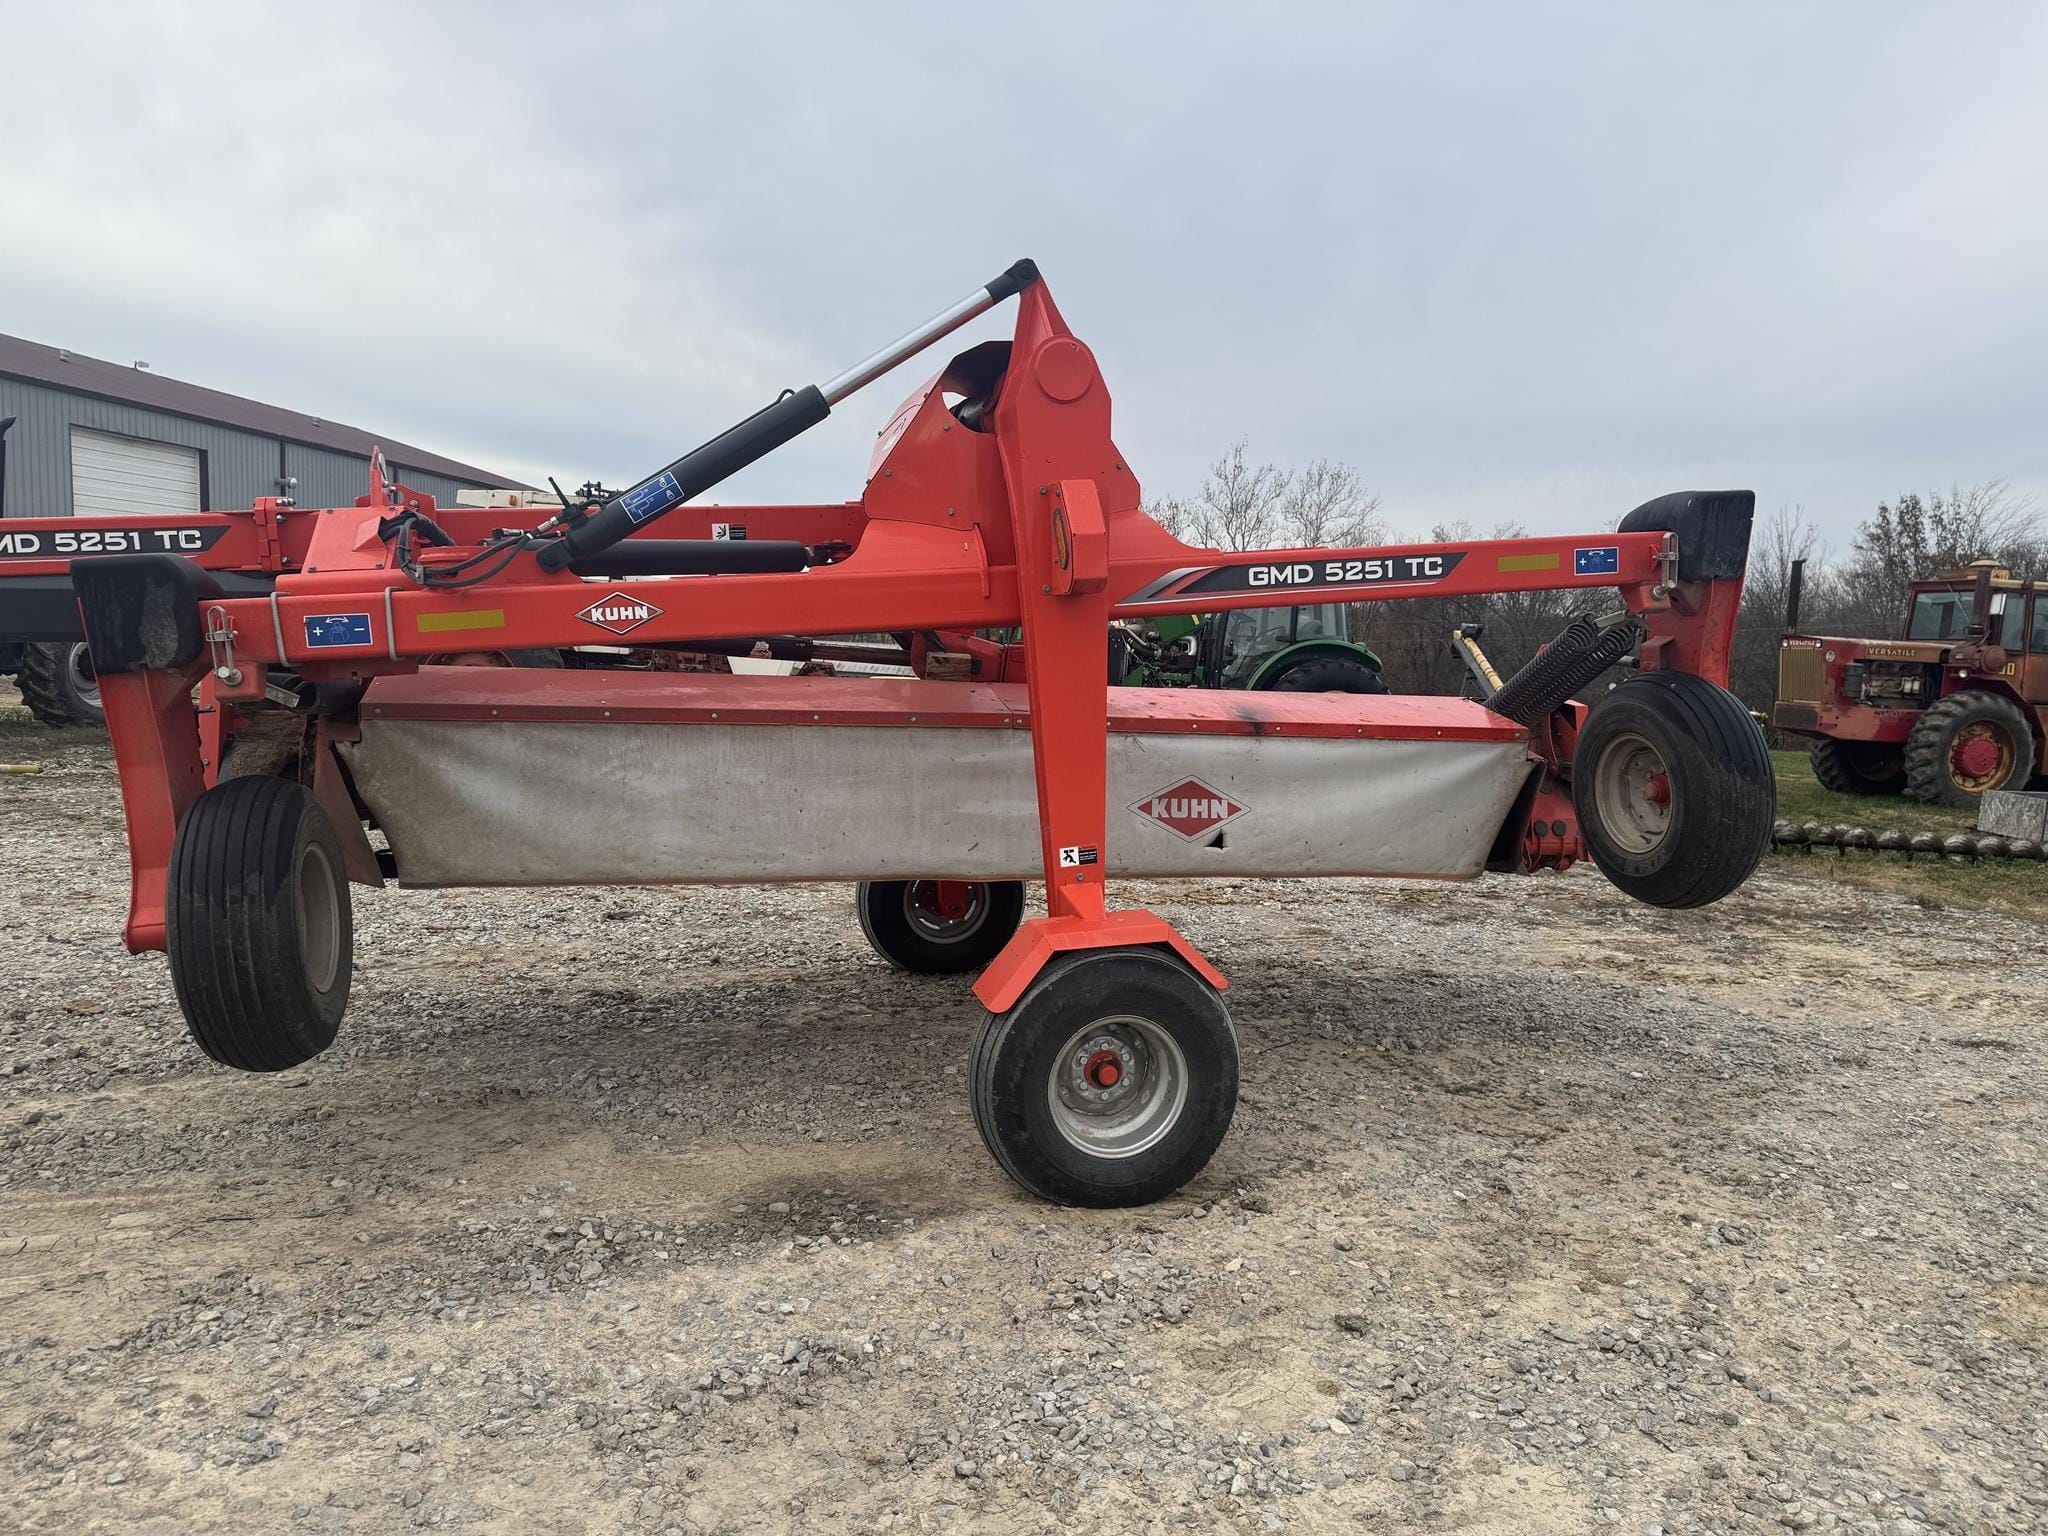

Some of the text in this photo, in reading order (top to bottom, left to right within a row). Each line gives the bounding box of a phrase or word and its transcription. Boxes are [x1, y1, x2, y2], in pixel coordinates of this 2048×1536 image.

[54, 531, 141, 552] 5251
[153, 529, 202, 550] TC
[1248, 556, 1443, 586] GMD 5251 TC
[591, 605, 649, 622] KUHN
[1868, 647, 1918, 657] VERSATILE
[1151, 797, 1229, 819] KUHN
